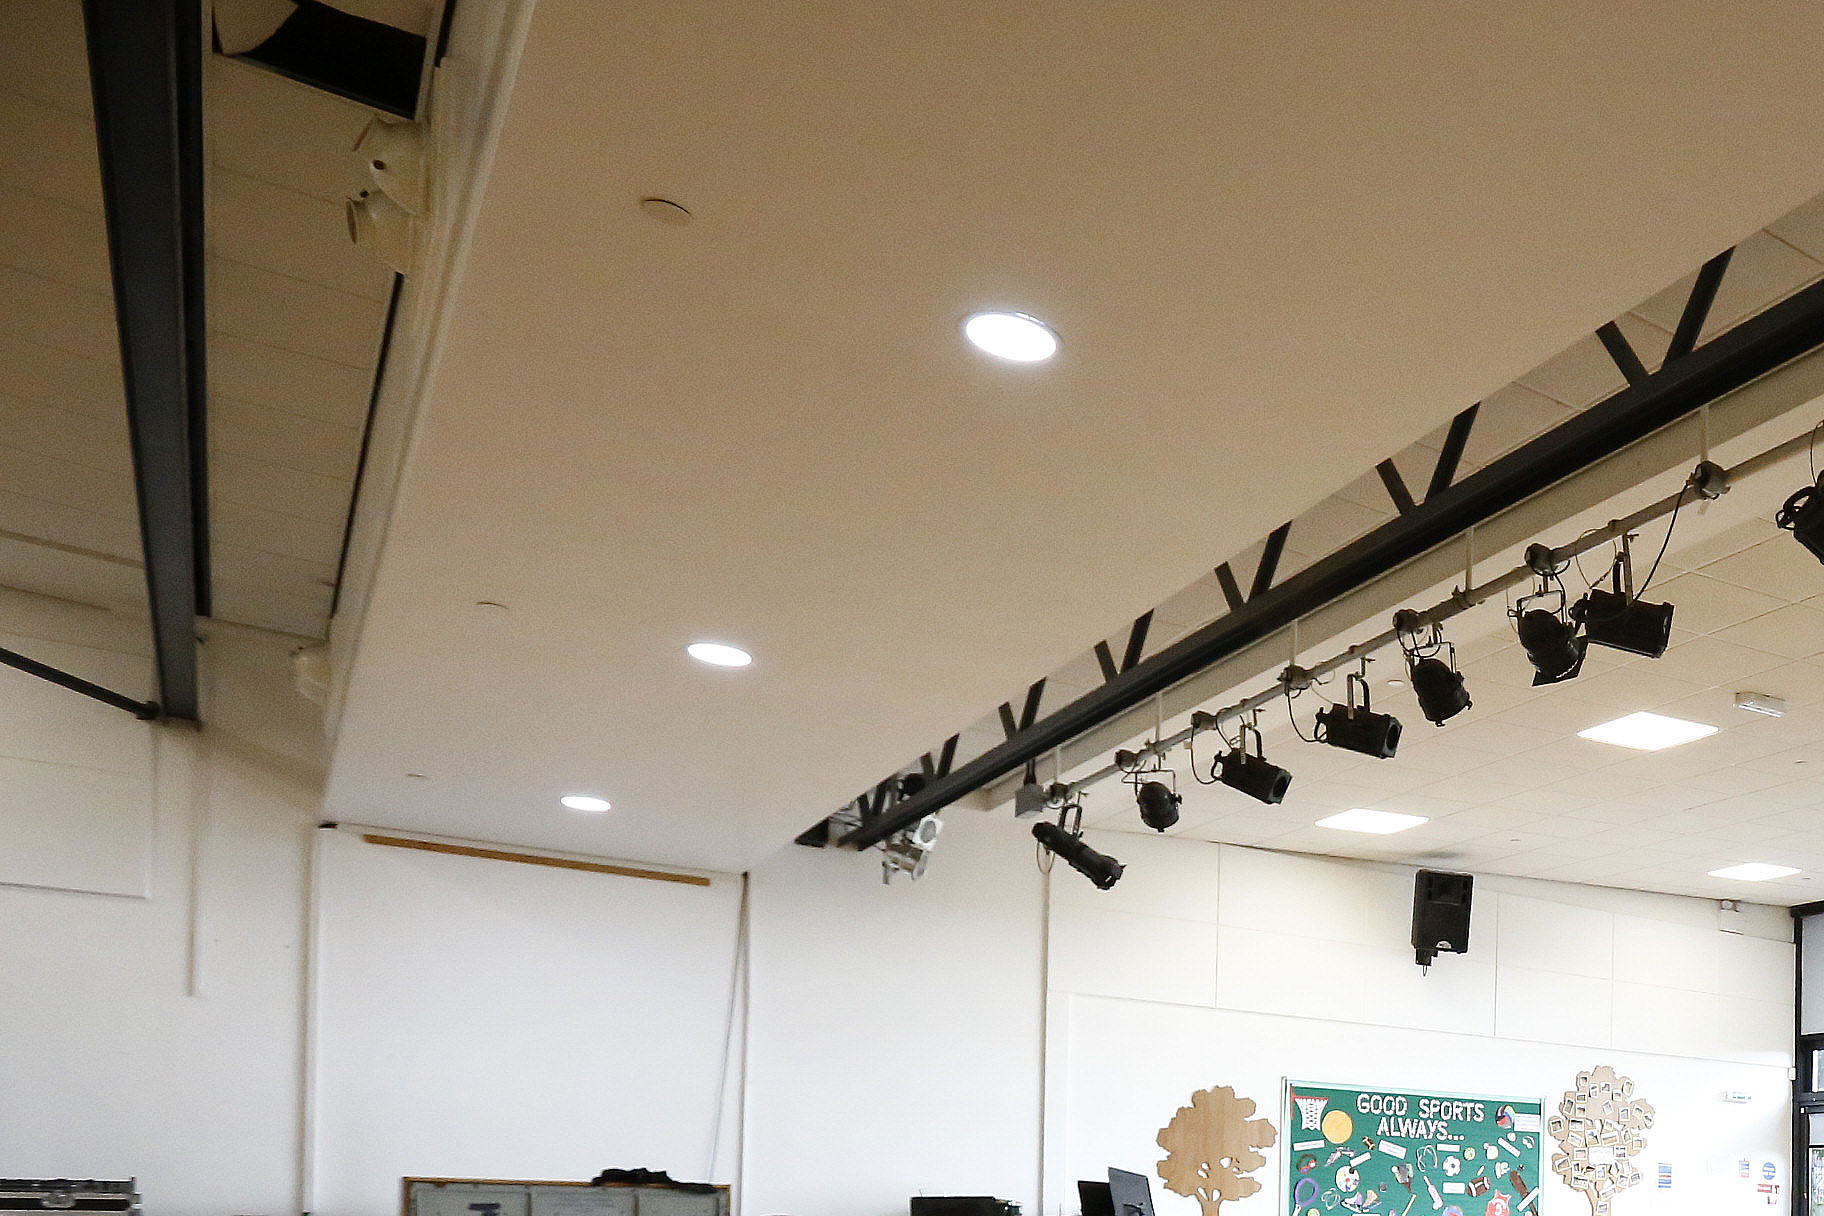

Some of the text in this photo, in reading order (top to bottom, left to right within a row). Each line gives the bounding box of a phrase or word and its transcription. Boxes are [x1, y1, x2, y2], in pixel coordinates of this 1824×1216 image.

[1356, 1093, 1485, 1122] GOOD SPORTS
[1376, 1116, 1465, 1141] ALWAYS...
